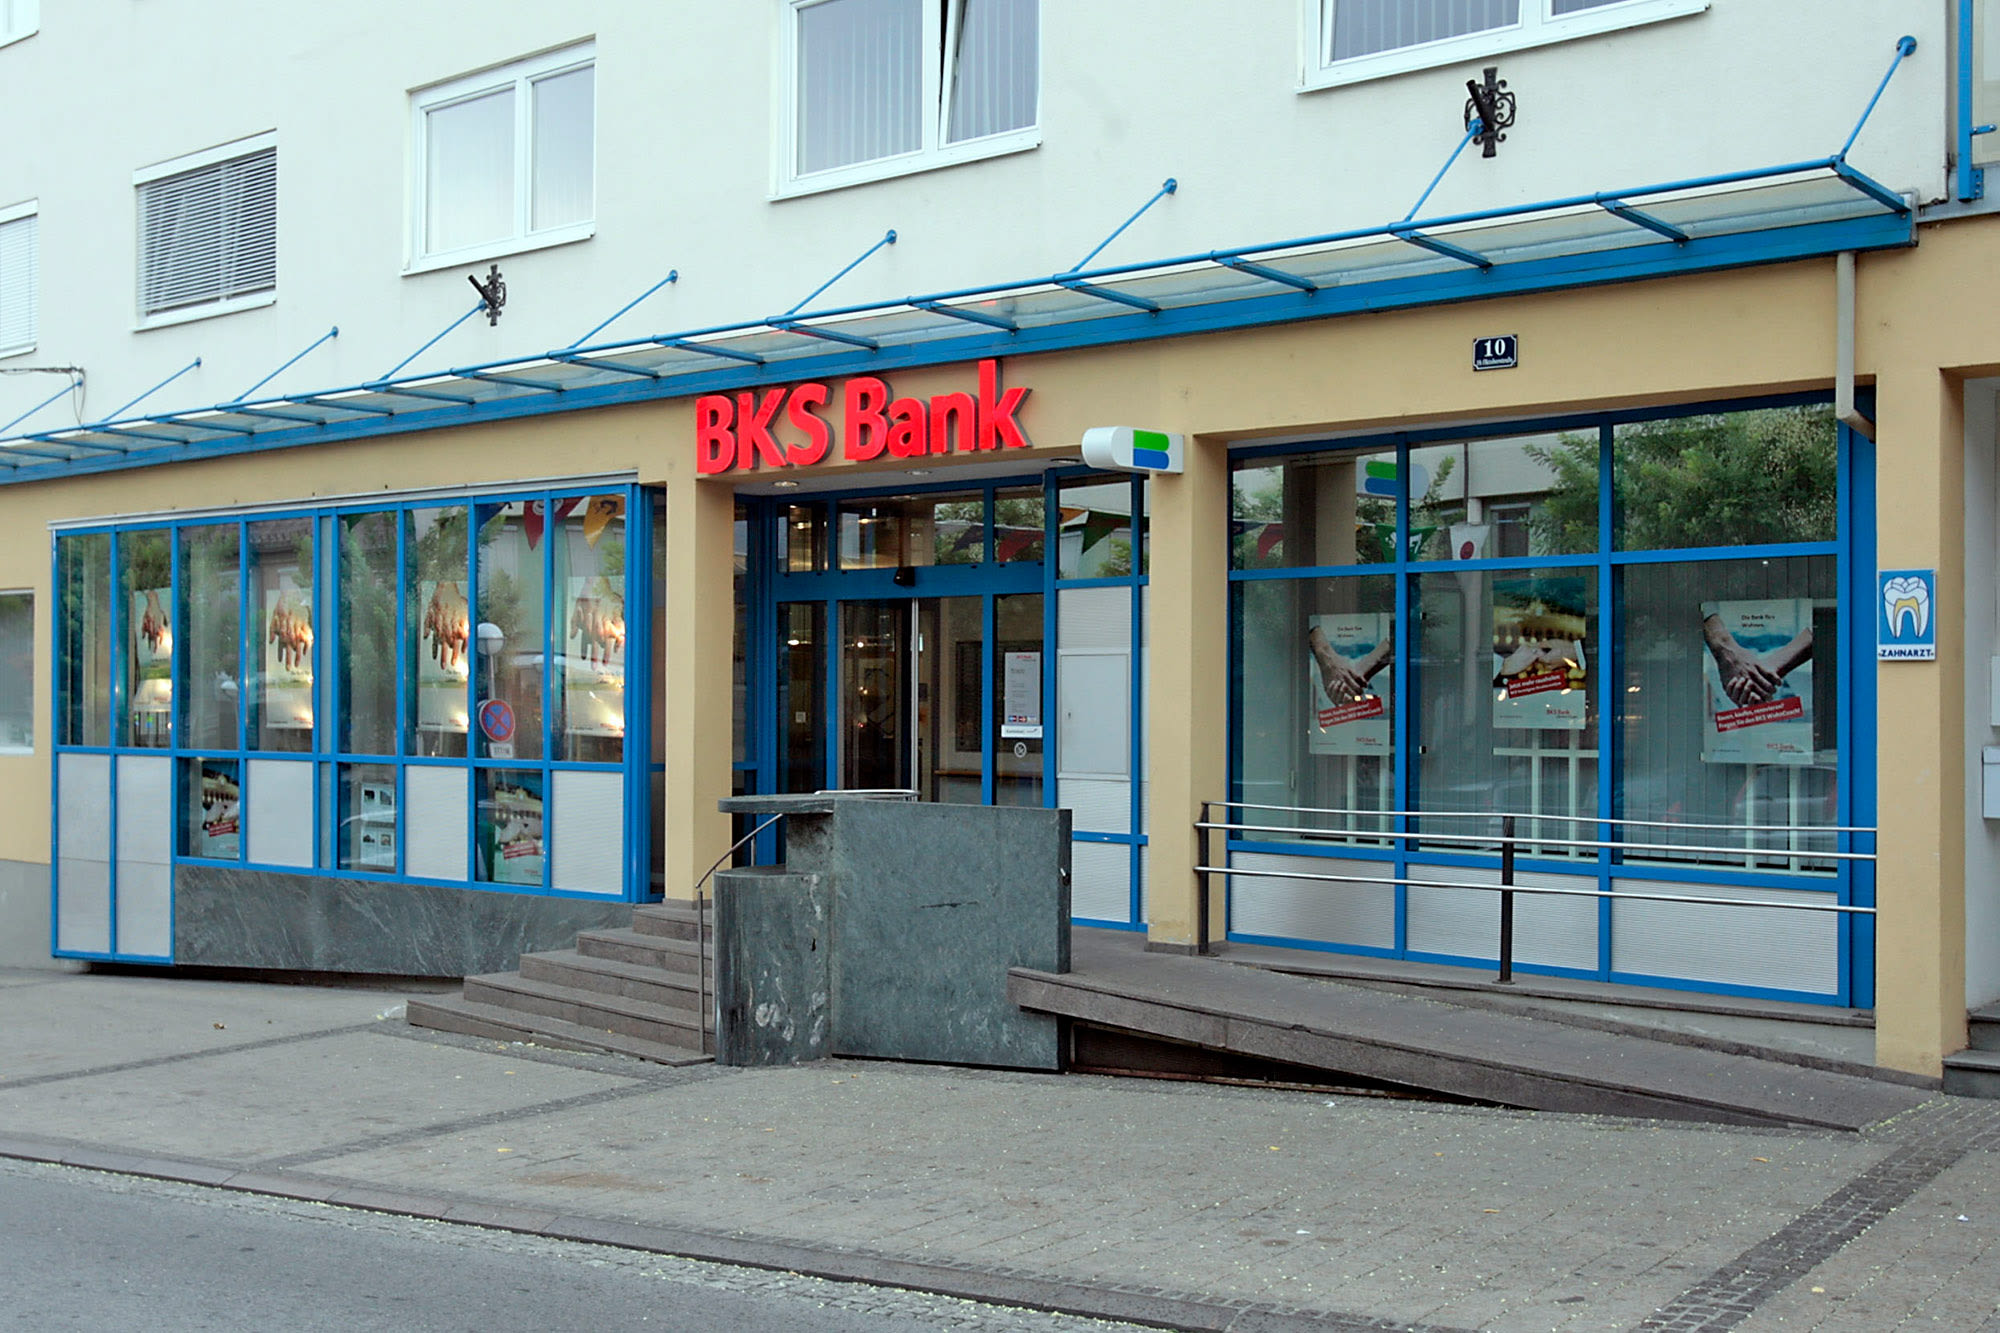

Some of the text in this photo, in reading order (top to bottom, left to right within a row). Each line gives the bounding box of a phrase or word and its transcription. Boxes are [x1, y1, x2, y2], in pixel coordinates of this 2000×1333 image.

[1484, 339, 1506, 357] 10
[696, 359, 1031, 475] BKS Bank
[1881, 648, 1931, 658] ZAHNARZT
